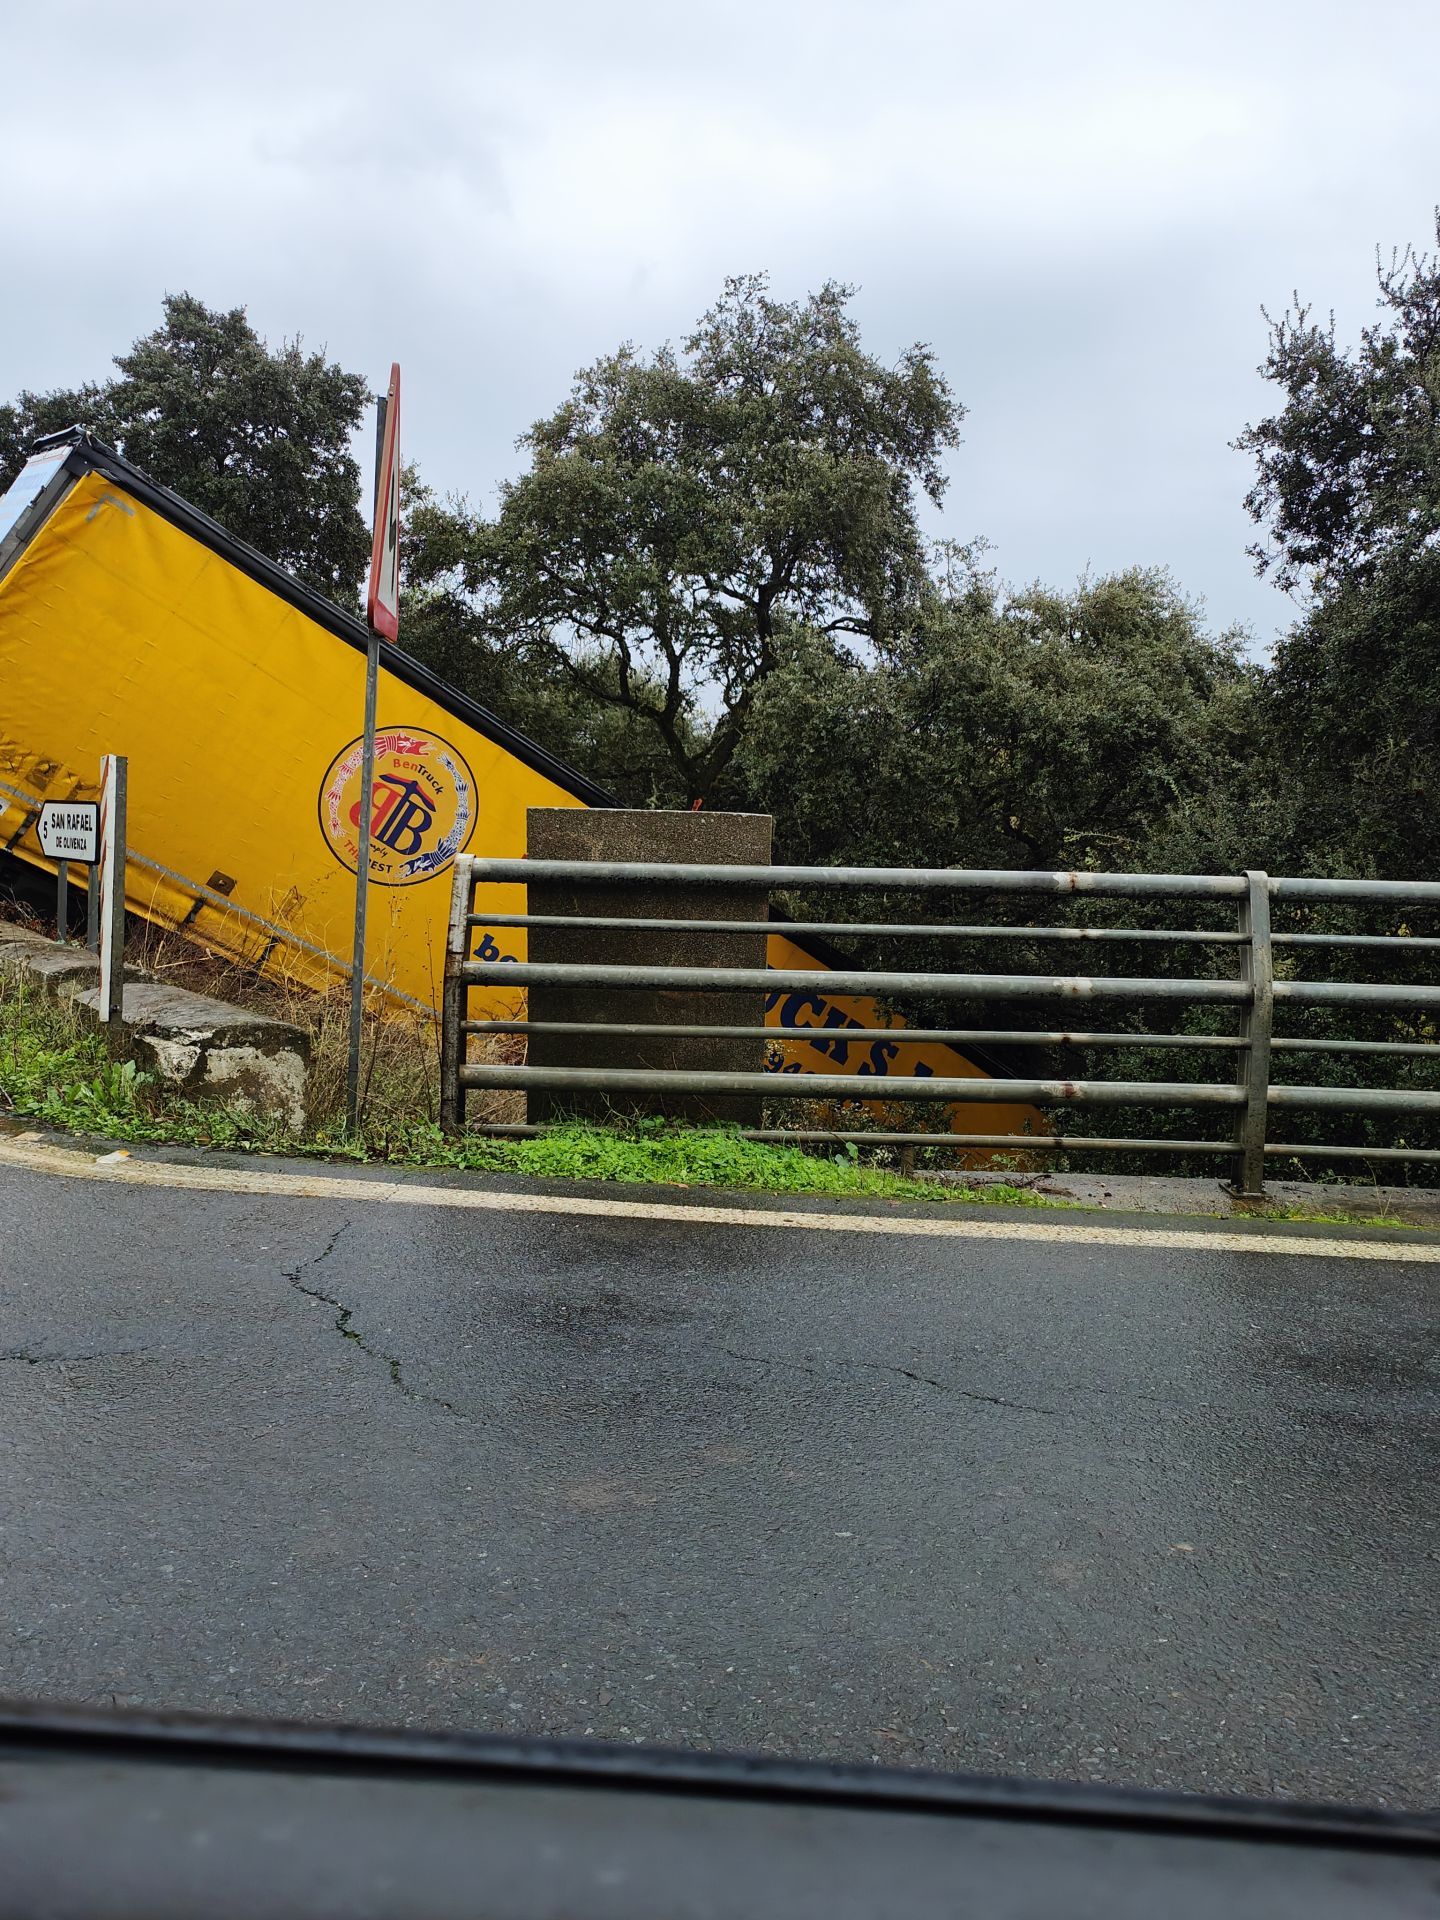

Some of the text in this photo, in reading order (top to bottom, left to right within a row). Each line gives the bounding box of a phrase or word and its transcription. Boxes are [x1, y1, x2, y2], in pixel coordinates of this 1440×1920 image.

[393, 758, 443, 795] BenTruck
[43, 821, 48, 839] 5
[51, 812, 93, 832] SAN RAFAEL
[55, 836, 87, 851] DE OLIVENZA
[369, 858, 393, 874] EST
